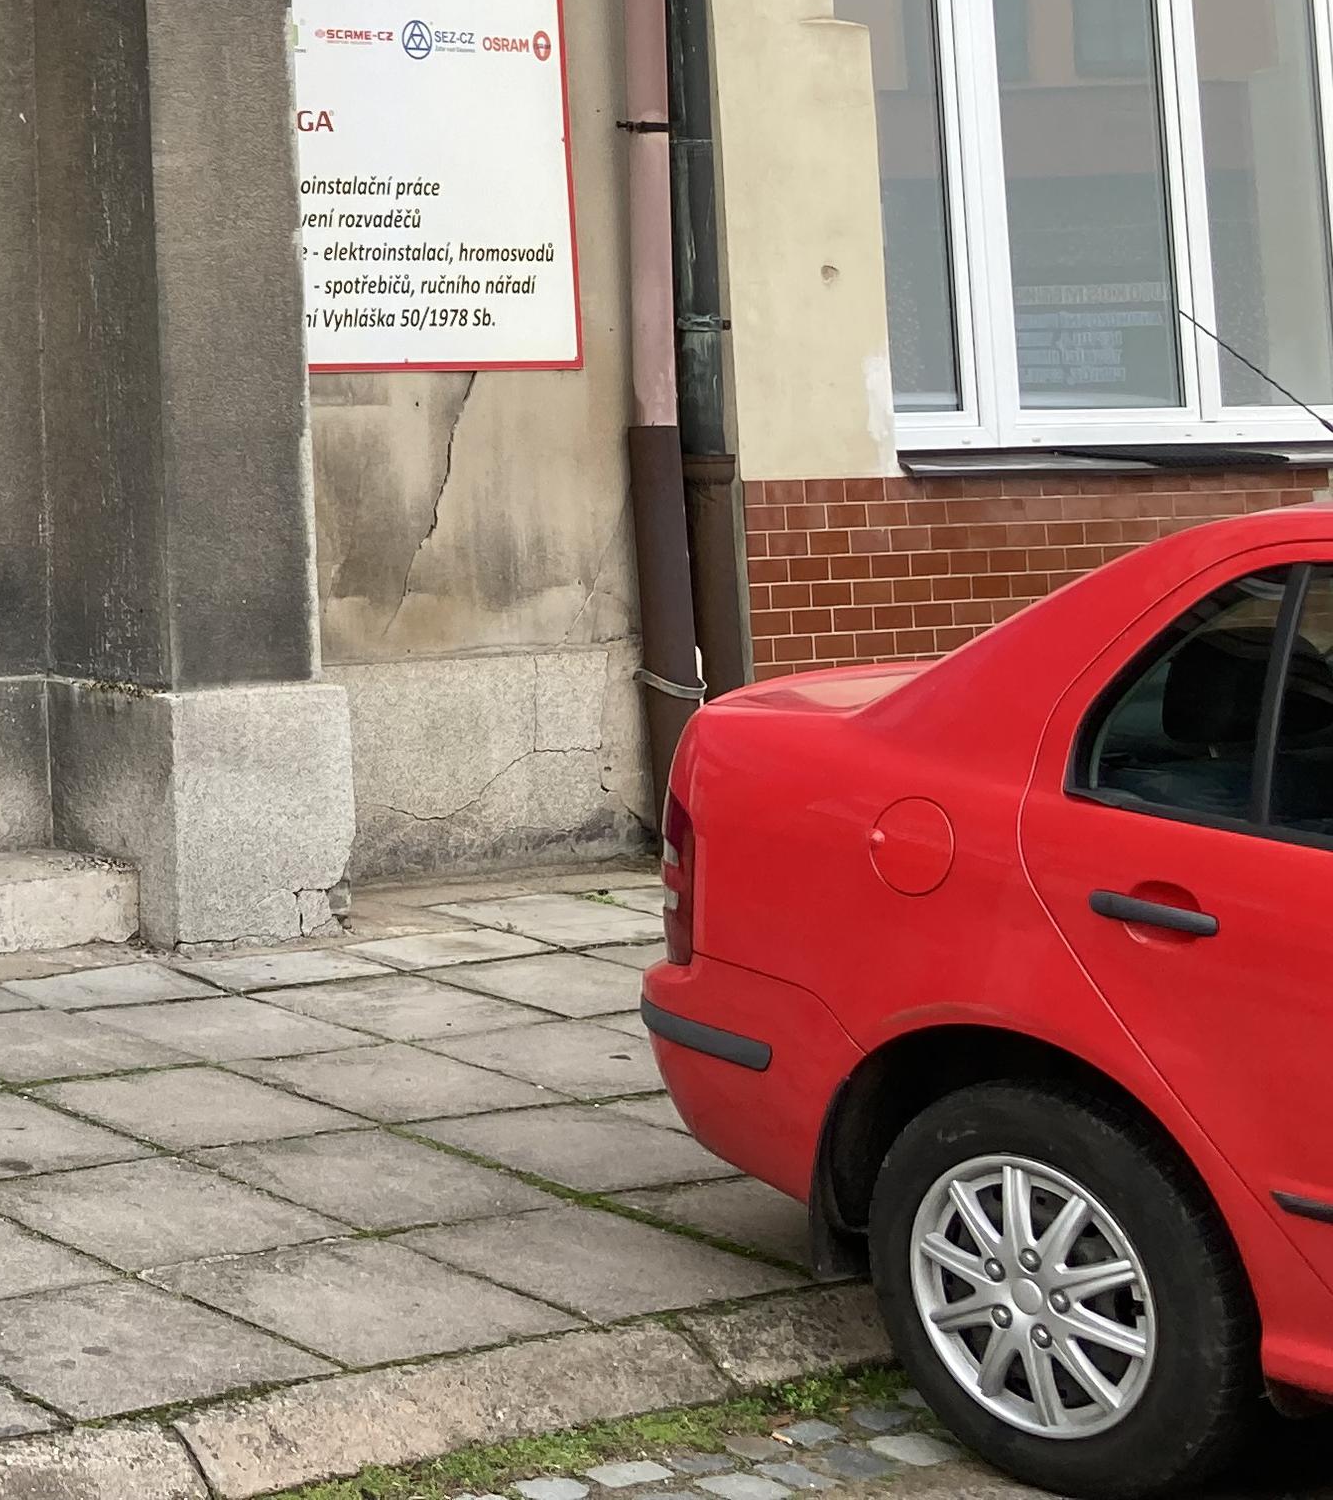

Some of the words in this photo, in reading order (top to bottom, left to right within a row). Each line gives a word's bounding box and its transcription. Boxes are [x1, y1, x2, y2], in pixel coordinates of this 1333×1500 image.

[434, 30, 475, 44] SEZ-CZ
[482, 37, 530, 53] OSRAM
[297, 110, 334, 132] GA
[300, 175, 392, 195] oinstalační
[395, 177, 441, 200] práce
[338, 208, 421, 228] rozvaděčů
[323, 241, 453, 265] elektroinstalací,
[458, 242, 554, 262] hromosvodů
[324, 274, 415, 299] spotřebičů,
[420, 275, 481, 294] ručního
[485, 275, 537, 294] nářadí
[323, 307, 396, 332] Vyhláška
[400, 306, 469, 331] 50/1978
[472, 308, 496, 327] Sb.
